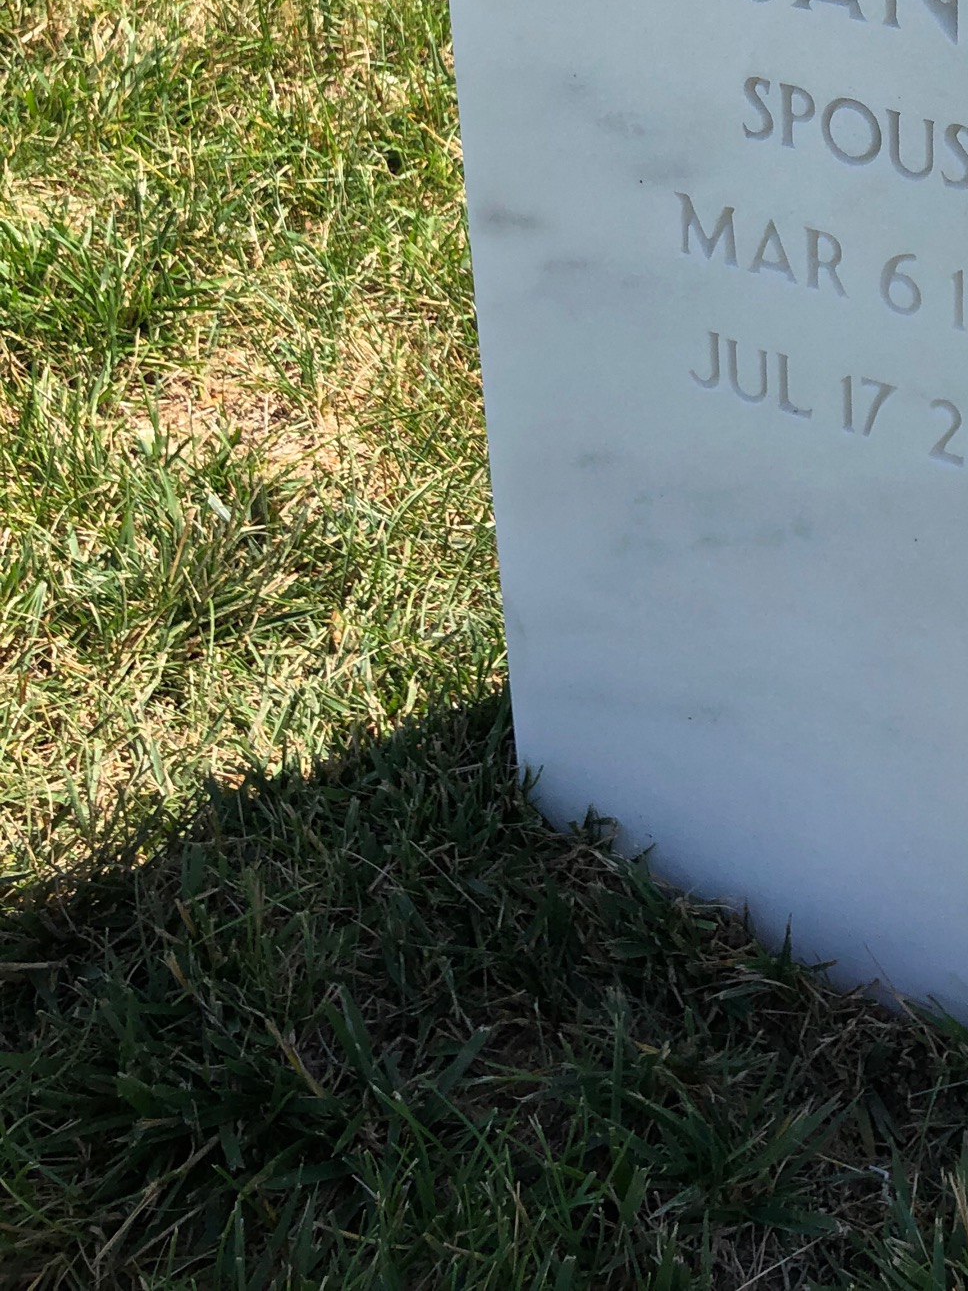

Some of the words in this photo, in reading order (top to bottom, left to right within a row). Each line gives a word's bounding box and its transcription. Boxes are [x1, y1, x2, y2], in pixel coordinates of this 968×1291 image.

[674, 191, 849, 299] MAR
[879, 253, 922, 316] 6
[689, 331, 813, 419] JUL
[840, 375, 898, 436] 17
